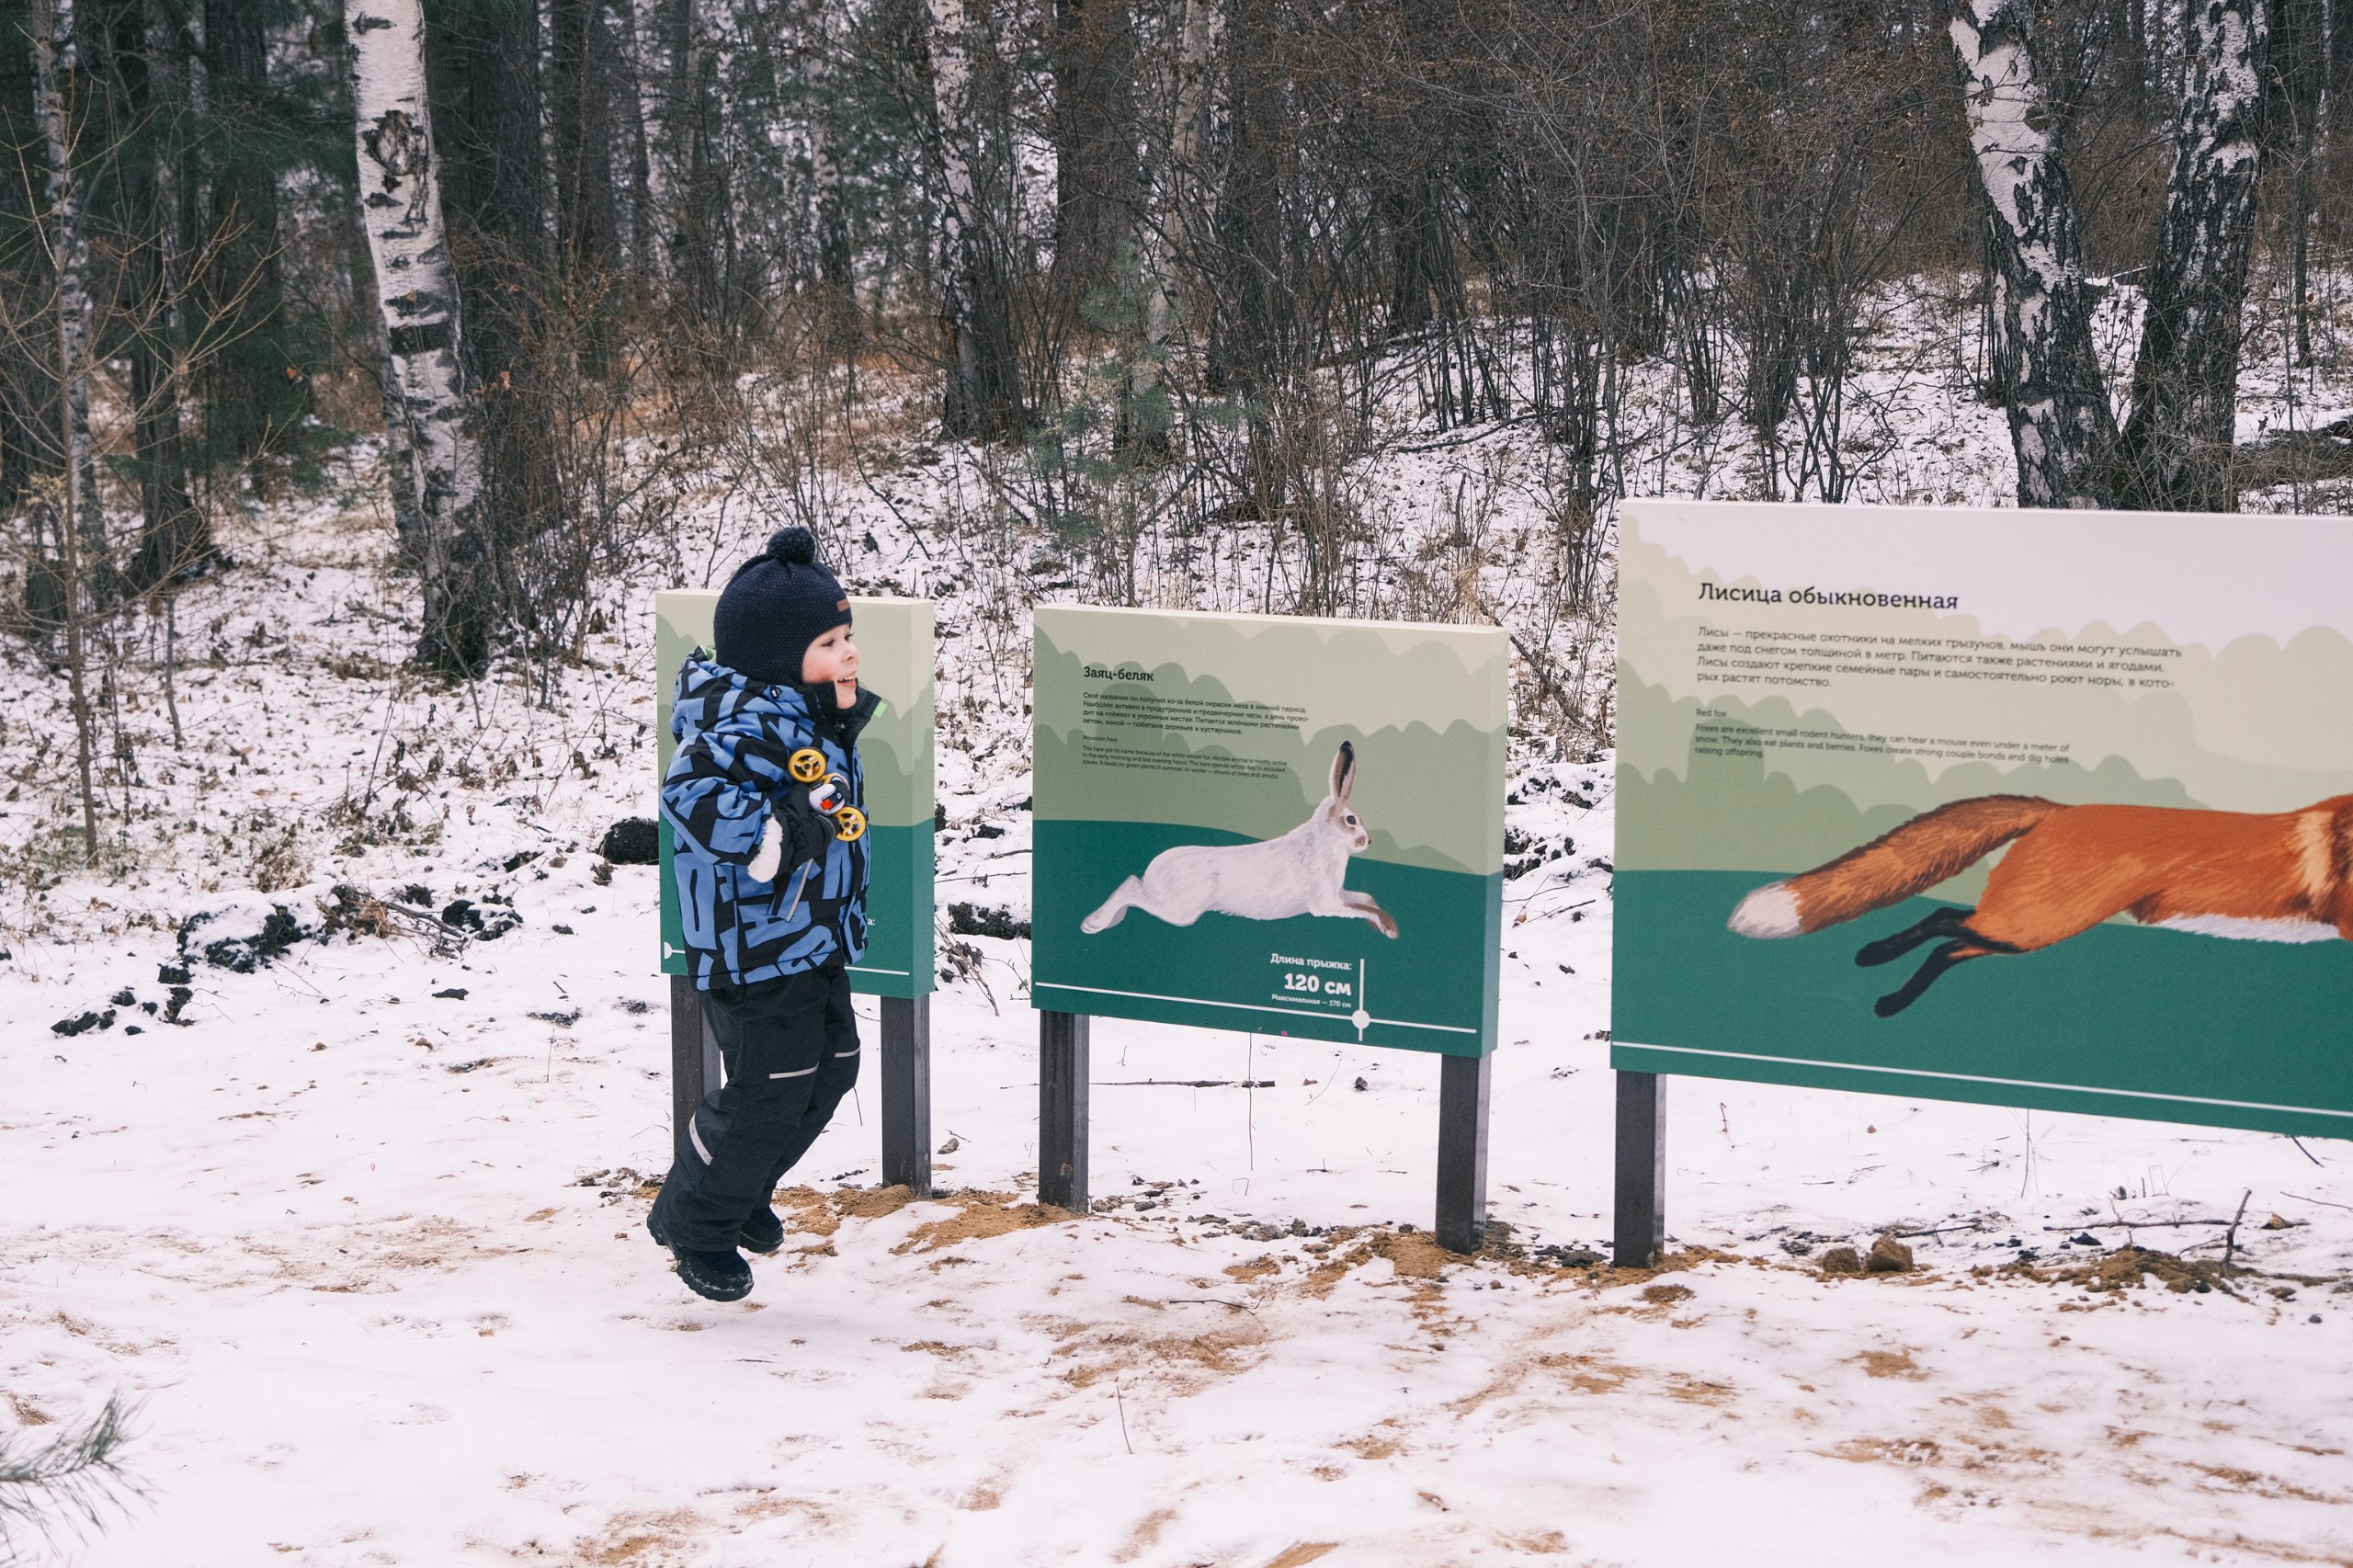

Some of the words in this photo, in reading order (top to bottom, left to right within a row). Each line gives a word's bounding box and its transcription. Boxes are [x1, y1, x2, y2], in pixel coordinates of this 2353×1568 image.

[1699, 582, 1781, 605] Лисица
[1789, 585, 1957, 610] обыкновенная
[1698, 626, 1729, 638] Лисы
[1745, 631, 1816, 644] прекрасные
[1819, 633, 1877, 644] охотники
[1880, 636, 1895, 645] на
[1898, 637, 1942, 647] мелких
[1945, 639, 2005, 653] грызунов,
[2009, 642, 2046, 652] мышь
[2049, 643, 2074, 653] они
[2076, 644, 2114, 657] могут
[2118, 646, 2182, 660] услышать
[1697, 643, 1726, 654] даже
[1729, 645, 1751, 655] под
[1754, 646, 1797, 656] снегом
[1800, 646, 1861, 660] толщиной
[1864, 651, 1871, 659] в
[1874, 652, 1907, 664] метр.
[1910, 651, 1972, 664] Питаются
[1976, 655, 2013, 665] также
[2016, 657, 2093, 672] растениями
[2096, 661, 2104, 669] и
[2108, 661, 2165, 673] ягодами.
[1083, 666, 1154, 683] Заяц-беляк
[1697, 655, 1728, 667] Лисы
[1730, 659, 1779, 671] создают
[1783, 661, 1832, 675] крепкие
[1835, 662, 1895, 675] семейные
[1898, 666, 1930, 678] пары
[1933, 668, 1941, 676] и
[1944, 668, 2047, 681] самостоятельно
[2050, 673, 2084, 686] роют
[2086, 675, 2122, 687] норы,
[2128, 676, 2135, 685] в
[2138, 677, 2173, 687] кото-
[1697, 673, 1719, 685] рых
[1722, 674, 1760, 687] растят
[1764, 676, 1832, 687] потомство.
[1083, 699, 1113, 709] Наиболее
[1145, 705, 1191, 715] предутренние
[1198, 709, 1245, 718] предвечерние
[1139, 697, 1165, 705] получил
[1184, 698, 1204, 706] белой
[1204, 700, 1232, 710] окраски
[1255, 703, 1279, 711] зимний
[1695, 708, 1711, 716] Red
[1713, 709, 1726, 717] fox
[1695, 723, 1719, 732] Foxes
[1735, 725, 1773, 735] excellent
[1775, 728, 1798, 736] small
[1799, 729, 1828, 738] rodent
[1829, 731, 1865, 741] hunters,
[1867, 733, 1886, 743] they
[1906, 734, 1927, 743] hear
[1993, 739, 2020, 748] under
[2029, 741, 2057, 750] meter
[2059, 743, 2069, 751] of
[1694, 746, 1723, 756] raising
[1724, 747, 1764, 758] offspring.
[1722, 736, 1743, 746] They
[1744, 737, 1762, 745] also
[1764, 738, 1777, 746] eat
[1779, 739, 1805, 750] plants
[1806, 741, 1824, 749] and
[1824, 742, 1857, 751] berries.
[1858, 744, 1883, 752] Foxes
[1884, 744, 1912, 754] create
[1914, 746, 1943, 757] strong
[1945, 748, 1975, 759] couple
[1977, 750, 2006, 759] bonds
[2007, 752, 2026, 760] and
[2028, 753, 2042, 763] dig
[2043, 754, 2069, 763] holes
[1270, 953, 1304, 965] Длина
[1307, 960, 1352, 970] прыжка:
[1284, 972, 1319, 993] 120
[1324, 982, 1351, 995] см
[1272, 994, 1320, 1005] Максимальная
